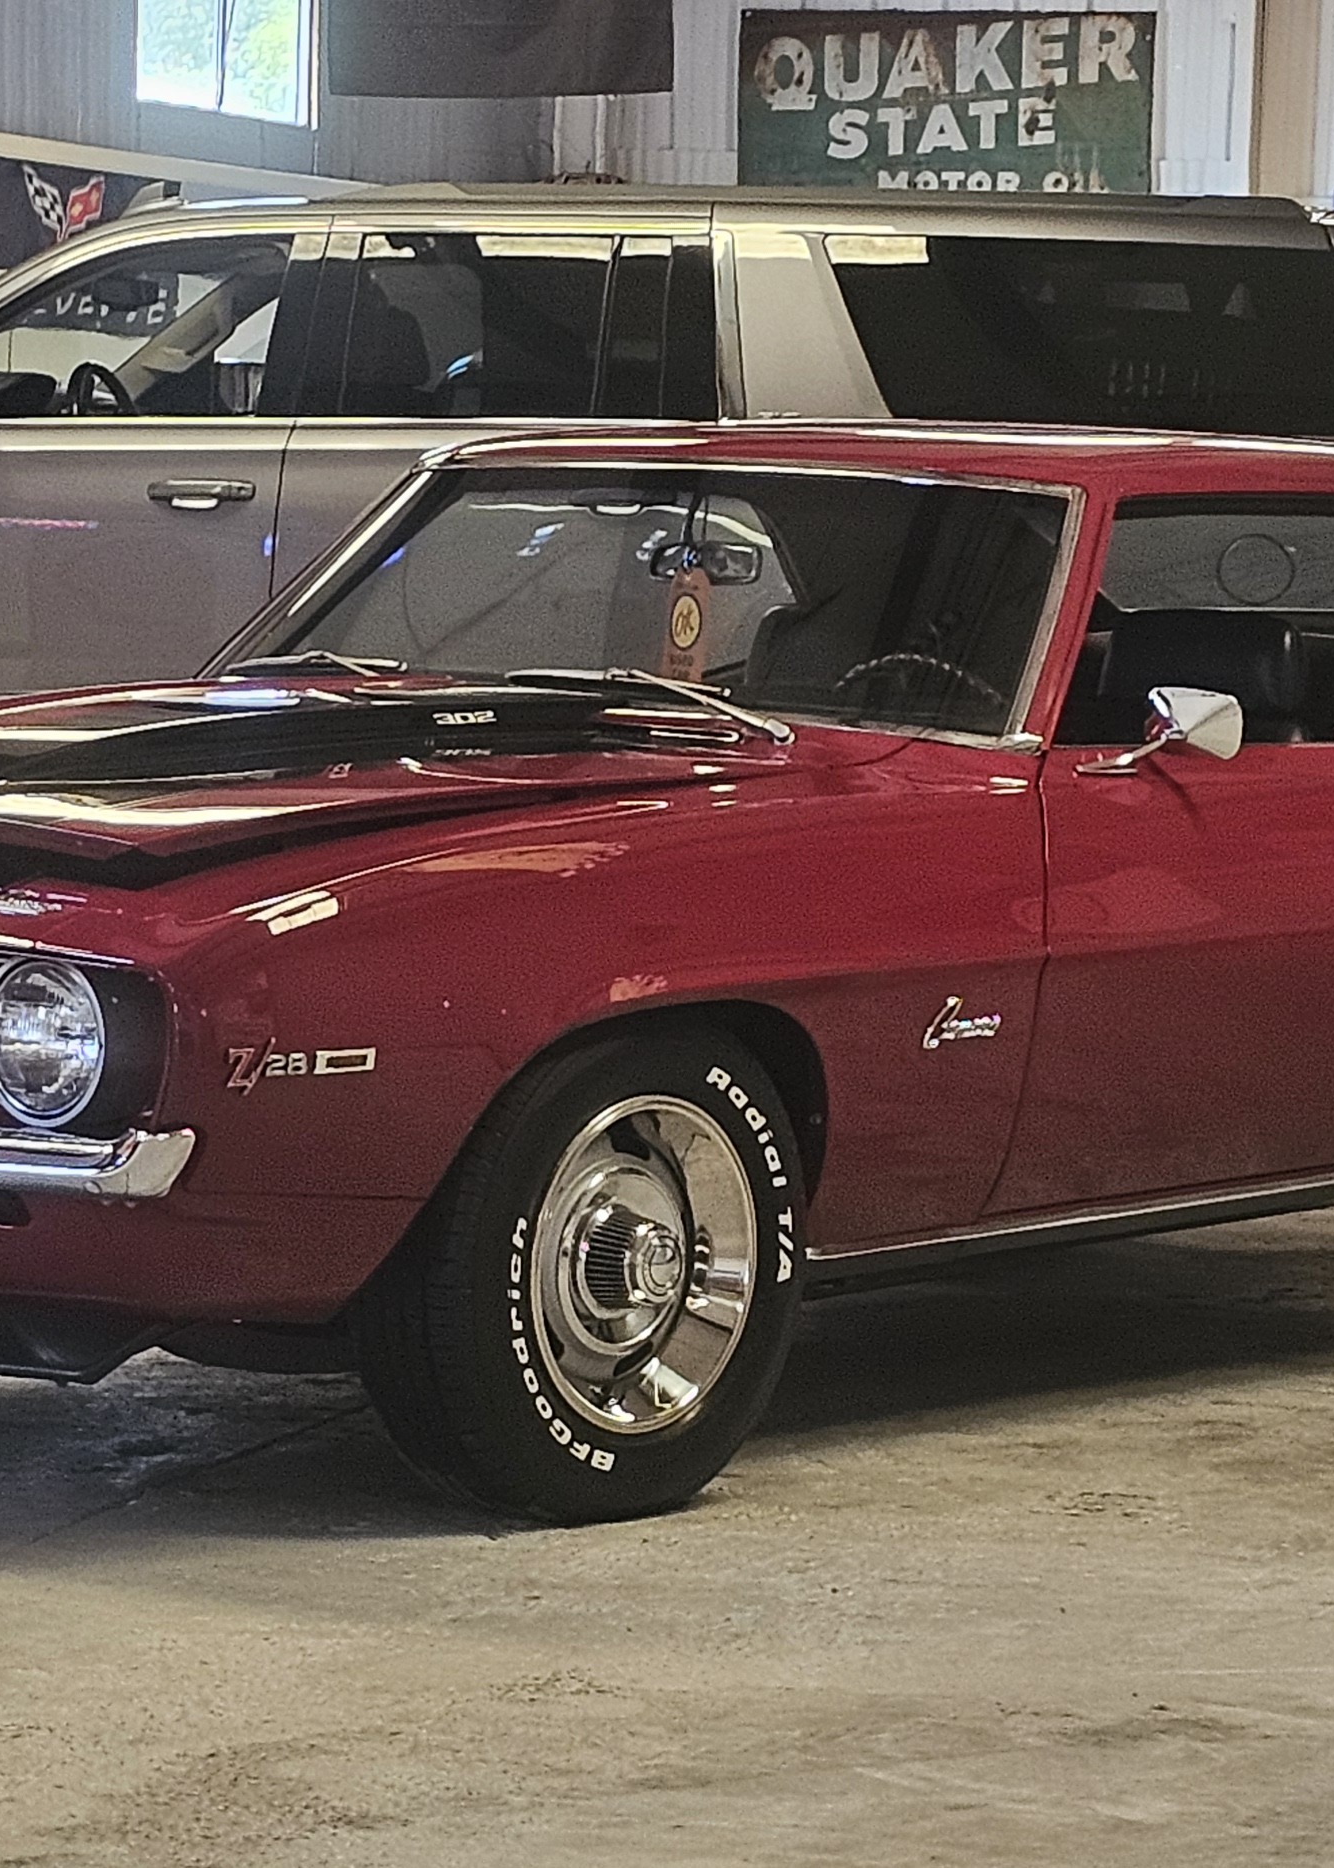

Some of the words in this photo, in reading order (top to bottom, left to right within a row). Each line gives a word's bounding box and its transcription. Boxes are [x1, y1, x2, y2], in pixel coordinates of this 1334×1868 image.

[754, 14, 1139, 111] QUAKER
[827, 98, 1057, 160] STATE
[877, 170, 1021, 192] MOTOR
[432, 710, 497, 725] 302
[227, 1037, 308, 1096] Z/28
[706, 1066, 788, 1188] Radial
[777, 1206, 794, 1284] T/A
[506, 1217, 616, 1473] BFGoodrich
